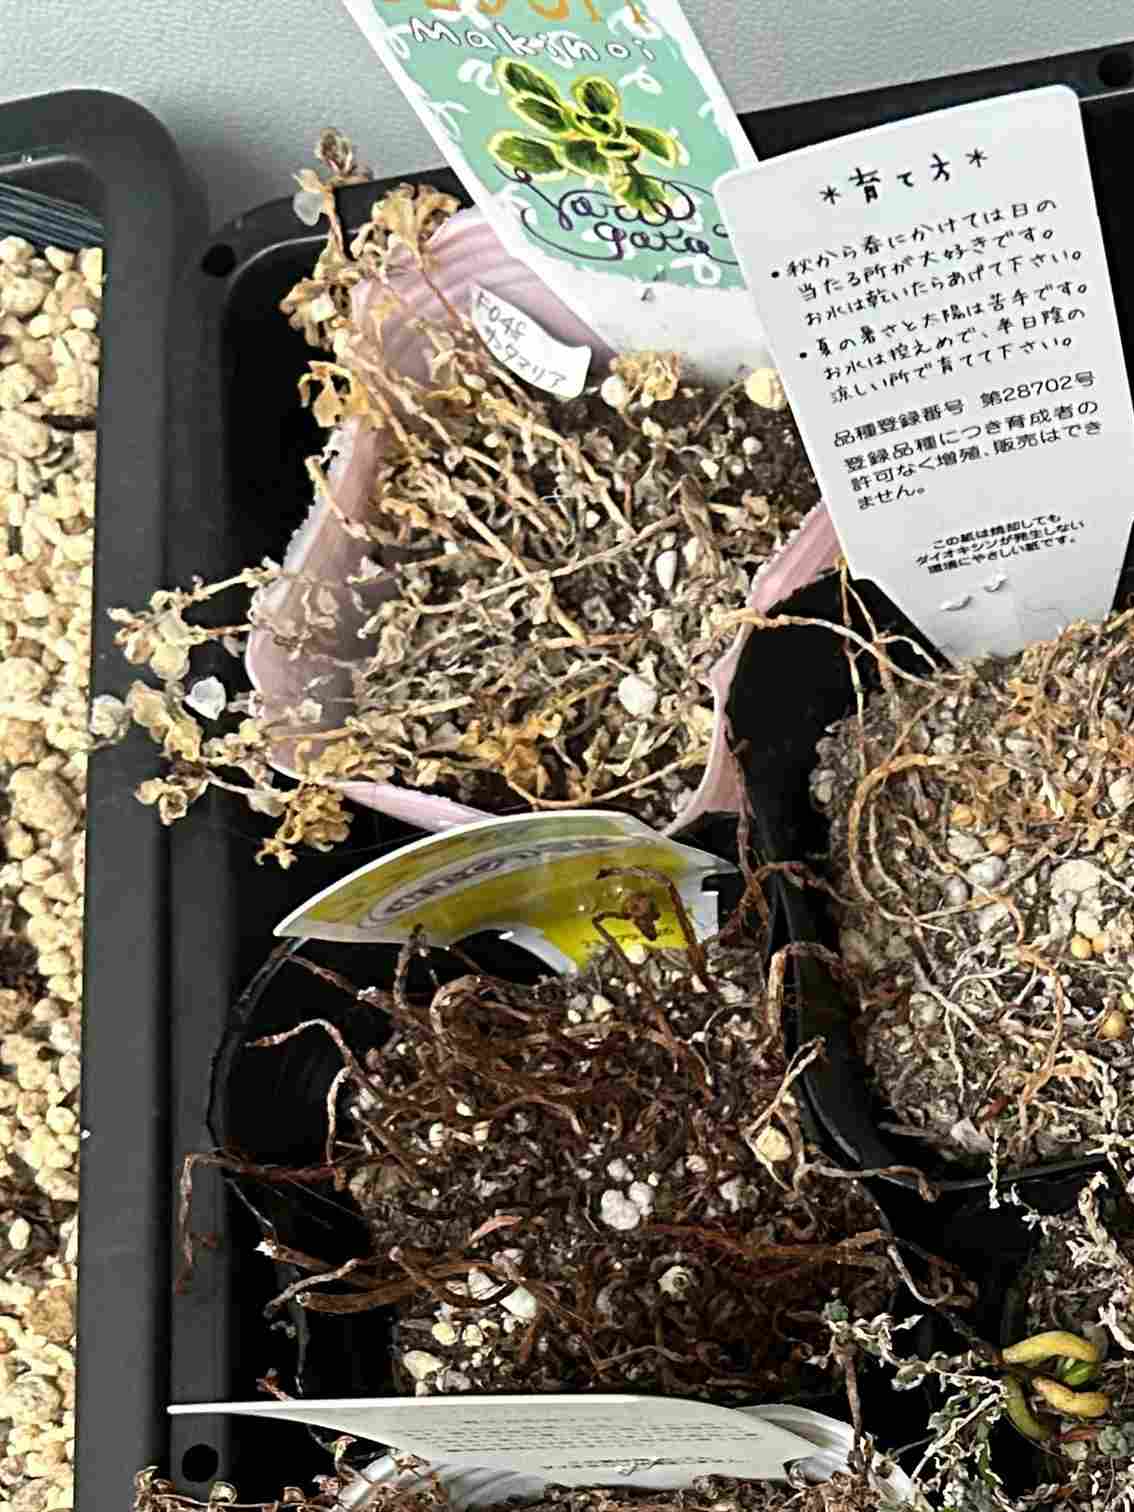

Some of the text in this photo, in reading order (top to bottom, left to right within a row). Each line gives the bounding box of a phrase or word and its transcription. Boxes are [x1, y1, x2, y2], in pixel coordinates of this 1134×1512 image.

[798, 226, 1054, 302] 当たる所が大好きです。
[805, 250, 1082, 327] お水は乾いたらあげて下さい。
[830, 336, 1072, 404] 涼しい所で育てて下さい。
[833, 370, 1096, 448] 品種登録番号 第28702号
[843, 400, 1099, 474] 登録品種につき育成者の
[850, 420, 1102, 493] 許可なく増殖、販売はでき
[857, 484, 926, 511] ません。
